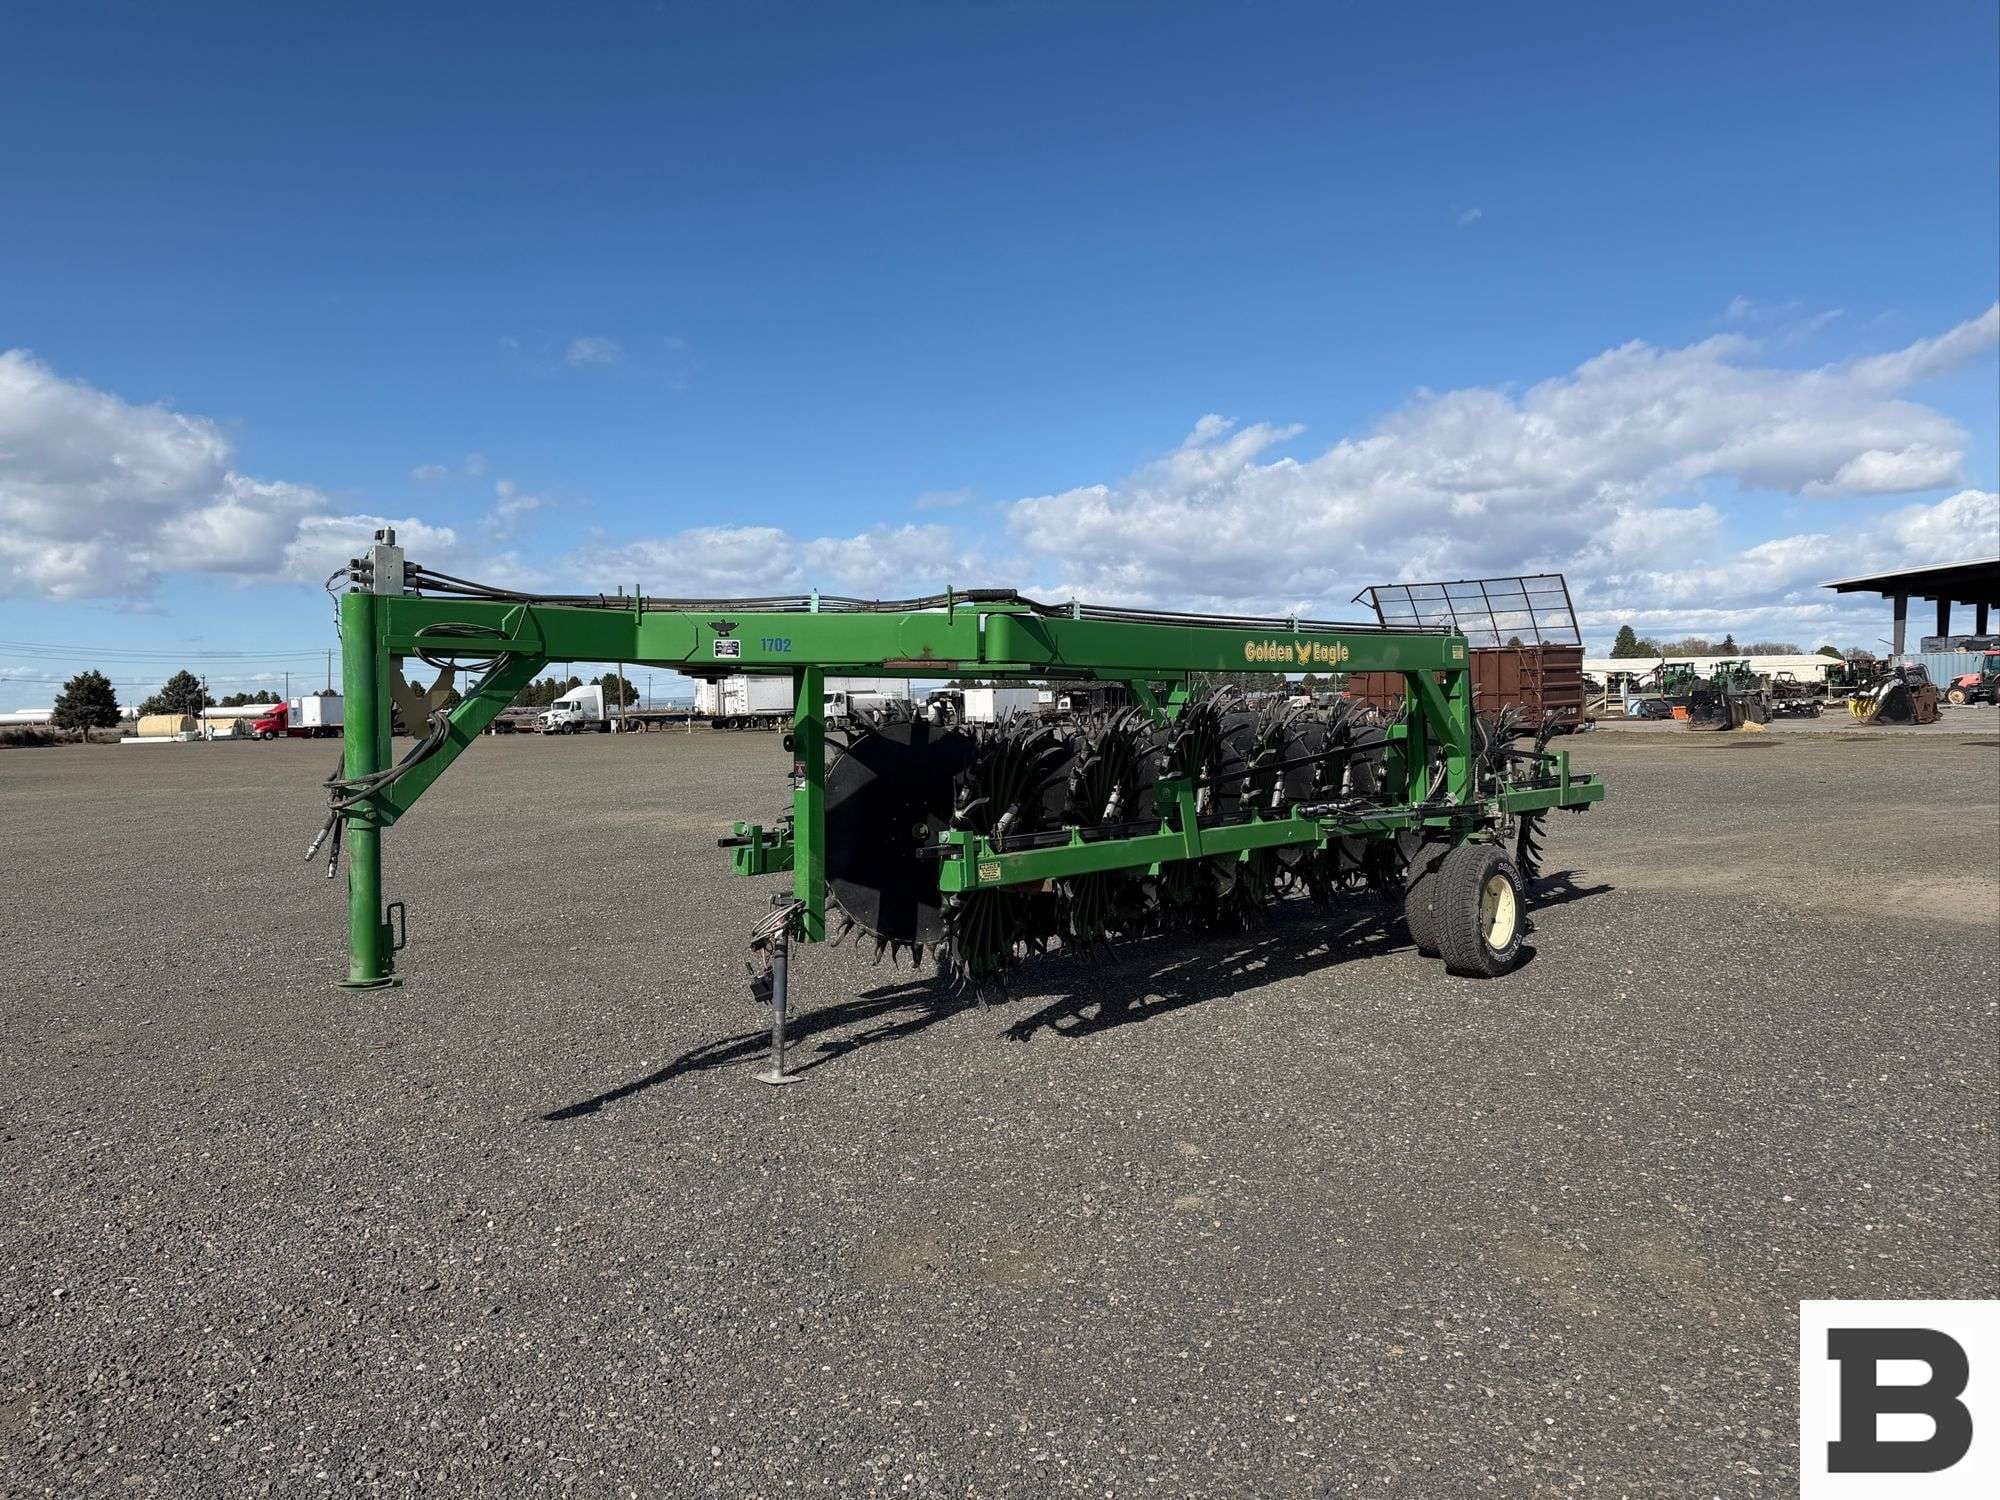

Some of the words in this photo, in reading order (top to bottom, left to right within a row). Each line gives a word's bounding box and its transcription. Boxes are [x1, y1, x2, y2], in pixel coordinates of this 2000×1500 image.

[761, 638, 792, 653] 1702
[1244, 640, 1294, 662] Golden
[1313, 641, 1349, 666] Eagle
